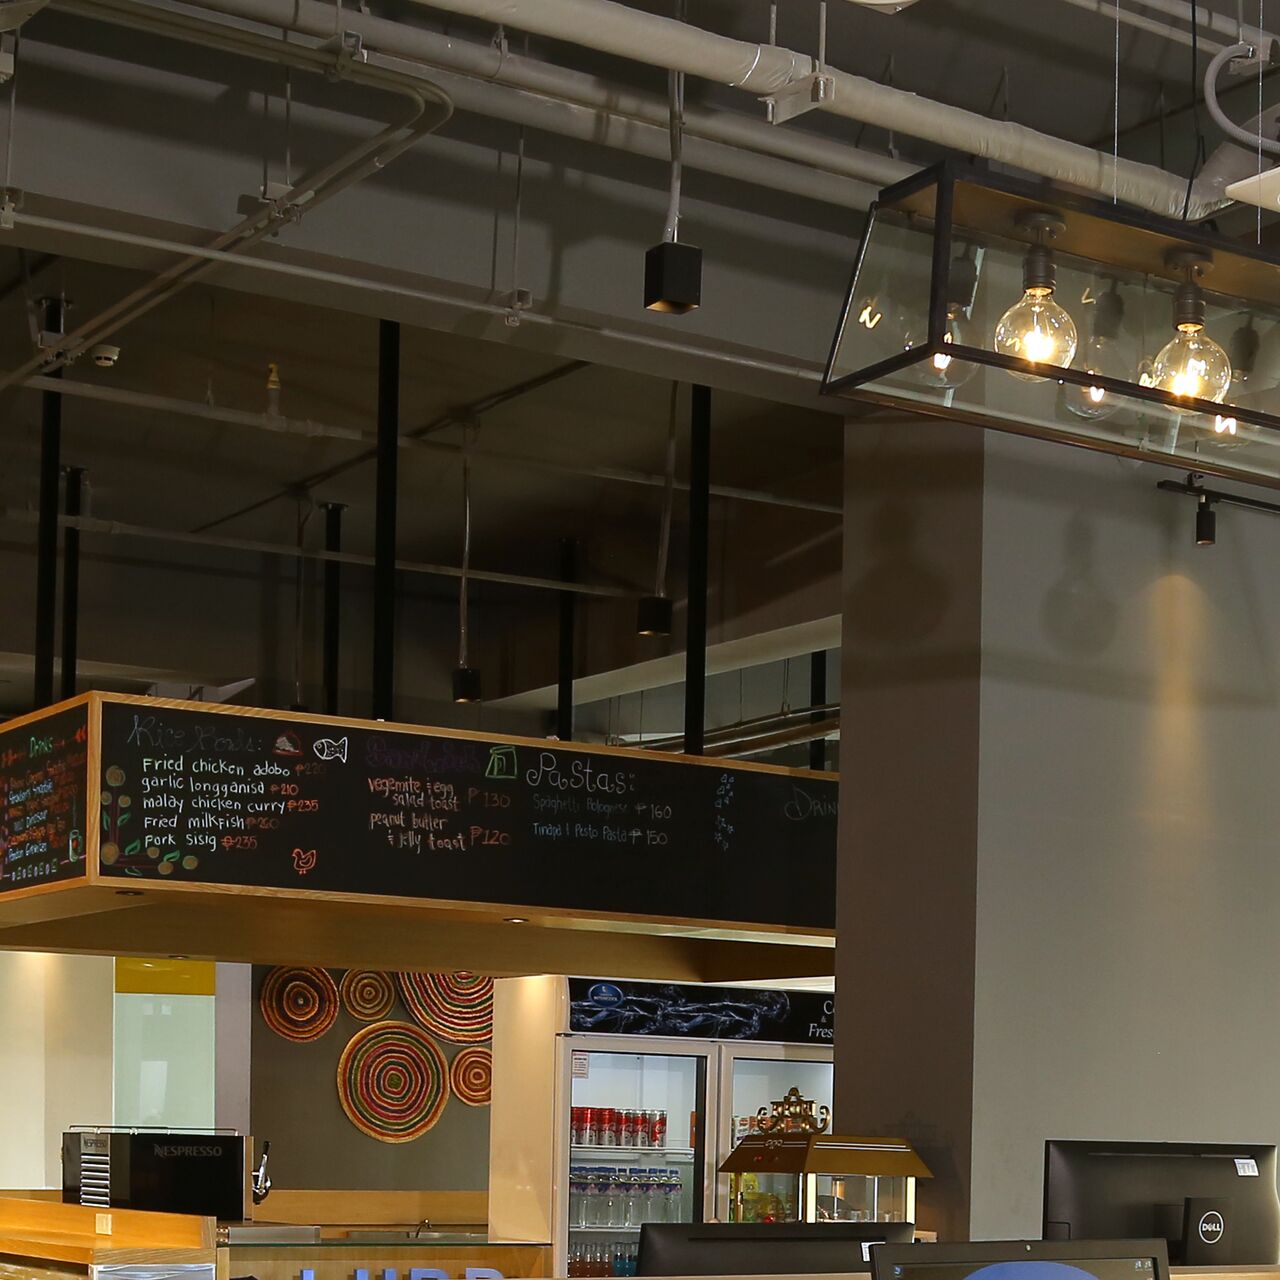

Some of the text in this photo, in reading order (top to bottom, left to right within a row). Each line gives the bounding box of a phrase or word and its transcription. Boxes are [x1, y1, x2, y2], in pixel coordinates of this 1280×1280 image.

[142, 753, 184, 773] Fried
[191, 757, 245, 776] chicken
[252, 760, 292, 777] adobo
[141, 773, 184, 793] garlic
[189, 776, 265, 797] longganisa
[433, 781, 454, 801] egg
[142, 795, 184, 813] malay
[191, 796, 242, 810] chicken
[247, 799, 286, 816] curry
[392, 792, 424, 808] salad
[430, 796, 460, 812] toast
[143, 812, 179, 830] Fried
[187, 811, 246, 831] milkfish
[369, 810, 449, 832] peanut butter
[429, 832, 467, 852] toast
[574, 822, 599, 839] Pesto
[601, 825, 628, 843] Pasta
[823, 1000, 835, 1015] C
[153, 1143, 223, 1158] NESPRESSO
[1202, 1222, 1221, 1232] DELL
